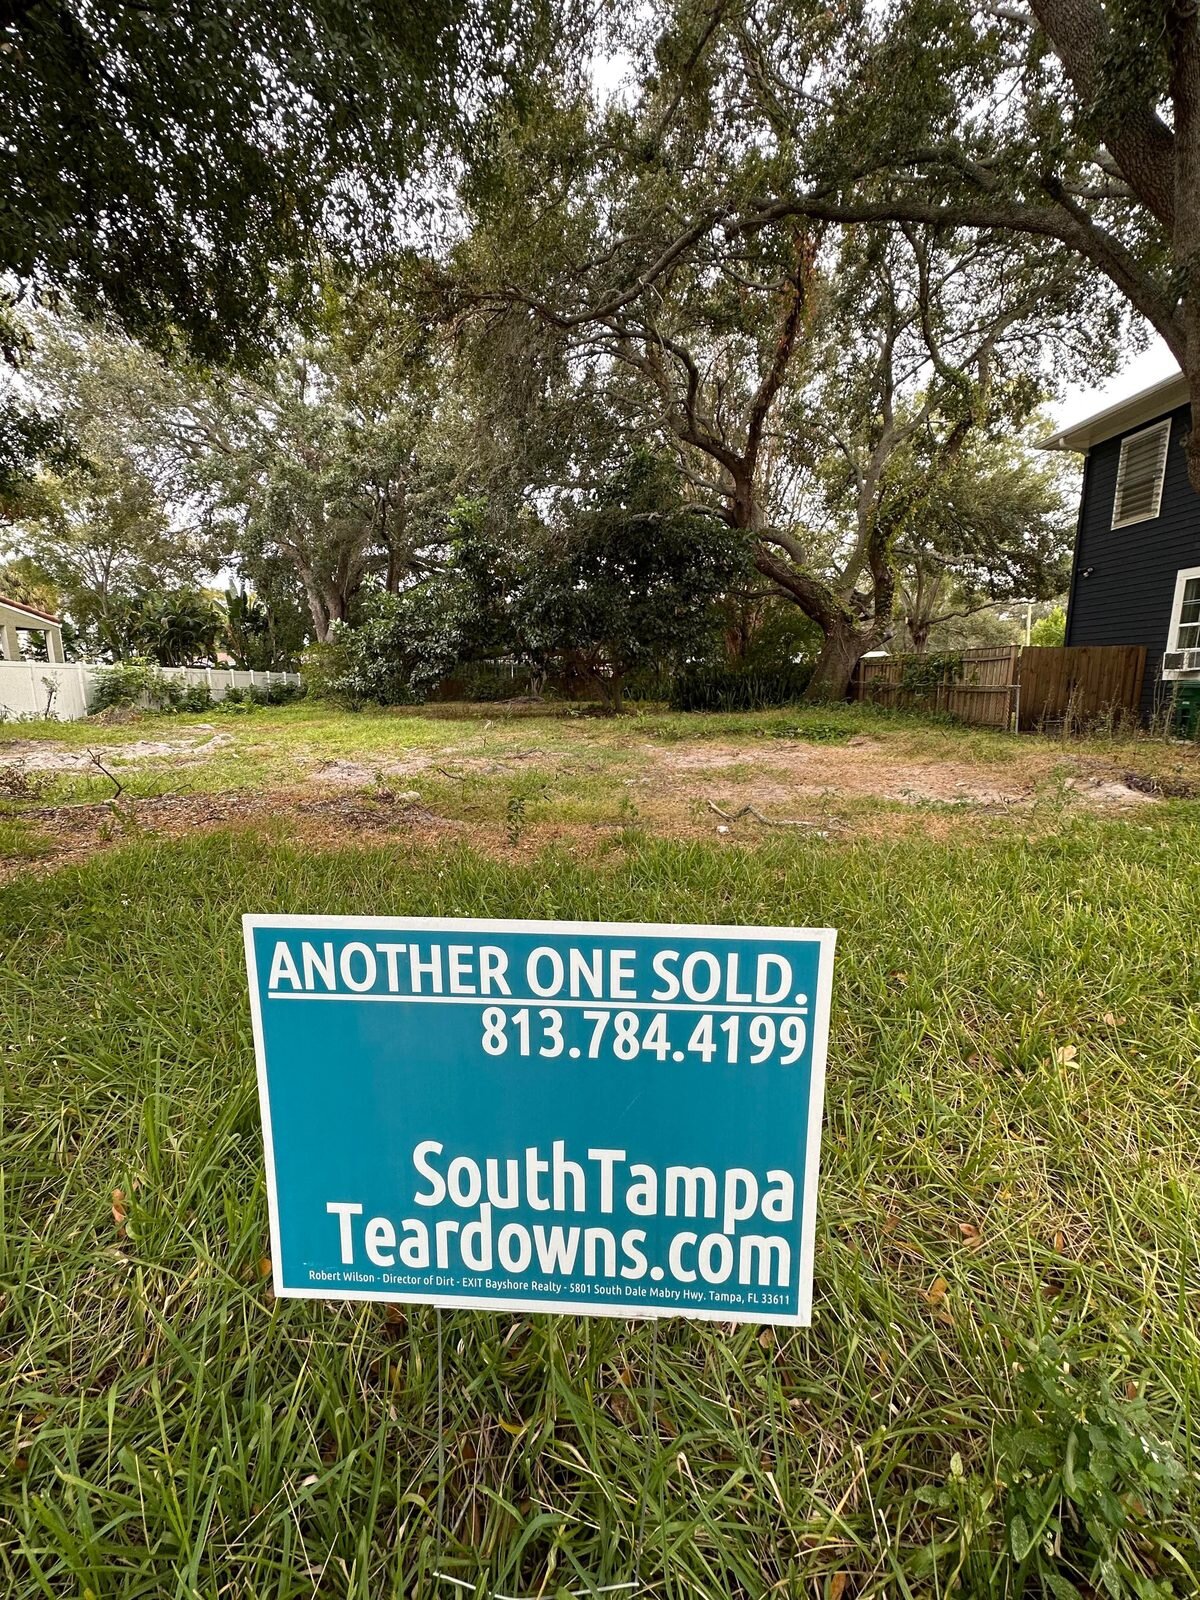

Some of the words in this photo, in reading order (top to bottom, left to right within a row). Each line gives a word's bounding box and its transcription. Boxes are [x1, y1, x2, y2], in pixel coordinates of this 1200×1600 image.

[268, 941, 513, 996] ANOTHER
[526, 946, 637, 1000] ONE
[651, 949, 808, 1006] SOLD.
[481, 1006, 807, 1065] 813.784.4199
[412, 1139, 795, 1235] SouthTampa
[326, 1201, 791, 1287] Teardowns.com
[309, 1270, 341, 1281] Robert
[343, 1271, 375, 1282] Wilson
[382, 1273, 421, 1285] Director
[423, 1275, 434, 1285] of
[435, 1276, 455, 1287] Dirt
[462, 1277, 483, 1288] EXIT
[485, 1278, 529, 1291] Bayshore
[531, 1280, 562, 1294] Realty
[569, 1283, 591, 1294] 5801
[594, 1284, 622, 1295] South
[625, 1286, 647, 1297] Dale
[649, 1287, 681, 1301] Mabry
[683, 1289, 706, 1302] Hwy.
[709, 1290, 745, 1304] Tampa,
[747, 1292, 759, 1304] FL
[761, 1293, 789, 1305] 33611
